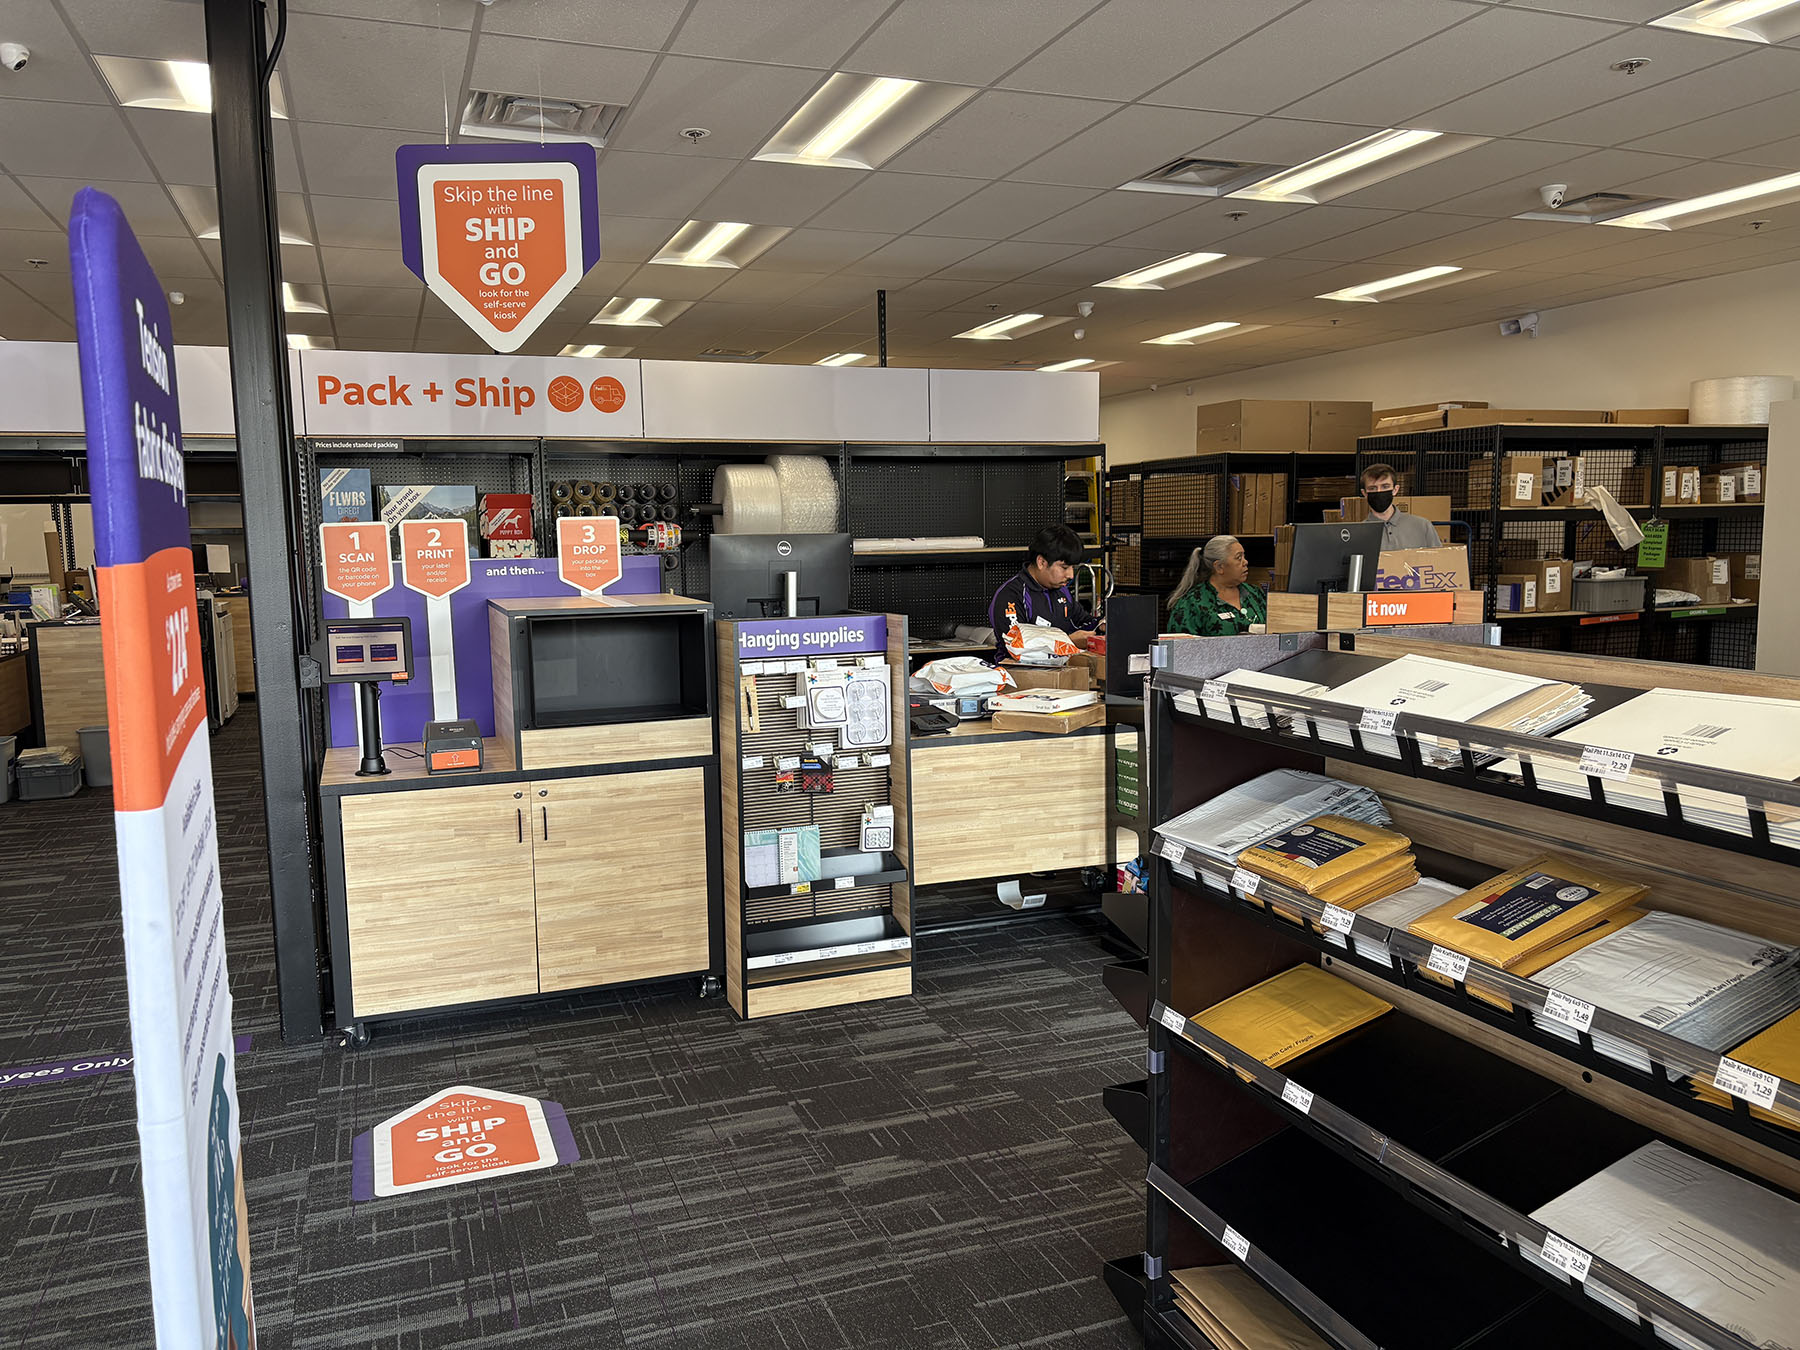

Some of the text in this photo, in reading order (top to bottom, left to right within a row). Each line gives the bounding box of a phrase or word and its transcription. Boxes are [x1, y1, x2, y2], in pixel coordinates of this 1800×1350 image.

[444, 185, 554, 206] Skip the line
[487, 204, 513, 215] with
[465, 217, 535, 242] SHIP
[484, 243, 519, 259] and
[479, 262, 526, 286] GO
[479, 289, 530, 298] look for the
[483, 300, 527, 309] self-serve
[493, 311, 517, 320] kiosk
[317, 376, 536, 416] Pack + Ship
[352, 442, 377, 450] standard
[377, 442, 399, 450] packing
[329, 492, 366, 506] FLWRS
[383, 488, 416, 518] Your brand.
[388, 491, 422, 524] On your box.
[349, 531, 361, 550] 1
[426, 528, 442, 547] 2
[581, 525, 596, 544] 3
[339, 552, 375, 564] SCAN
[416, 549, 454, 560] PRINT
[573, 545, 607, 556] DROP
[585, 558, 609, 566] package
[486, 565, 545, 577] and then...
[1376, 565, 1457, 590] FedEx
[1368, 599, 1408, 617] it now
[803, 626, 865, 648] supplies
[1603, 750, 1621, 758] 11.5x14
[1612, 761, 1627, 770] $2.29
[1562, 995, 1573, 1004] Poly
[1574, 1009, 1589, 1021] $1.49
[1268, 1051, 1280, 1060] with
[1280, 1045, 1293, 1054] Care
[1295, 1034, 1314, 1046] Fragile
[72, 1058, 134, 1071] Only
[1737, 1065, 1752, 1076] Kraft
[1752, 1071, 1763, 1079] 6x9
[1764, 1075, 1774, 1084] 1Ct
[1754, 1082, 1772, 1096] $1.29
[426, 1104, 493, 1120] the line
[439, 1099, 478, 1111] Skip
[447, 1115, 474, 1124] with
[416, 1117, 507, 1143] SHIP
[441, 1132, 487, 1148] and
[433, 1143, 497, 1163] GO
[425, 1159, 512, 1179] self-serve kiosk
[436, 1157, 499, 1172] look for the
[1572, 1257, 1586, 1270] $2.29
